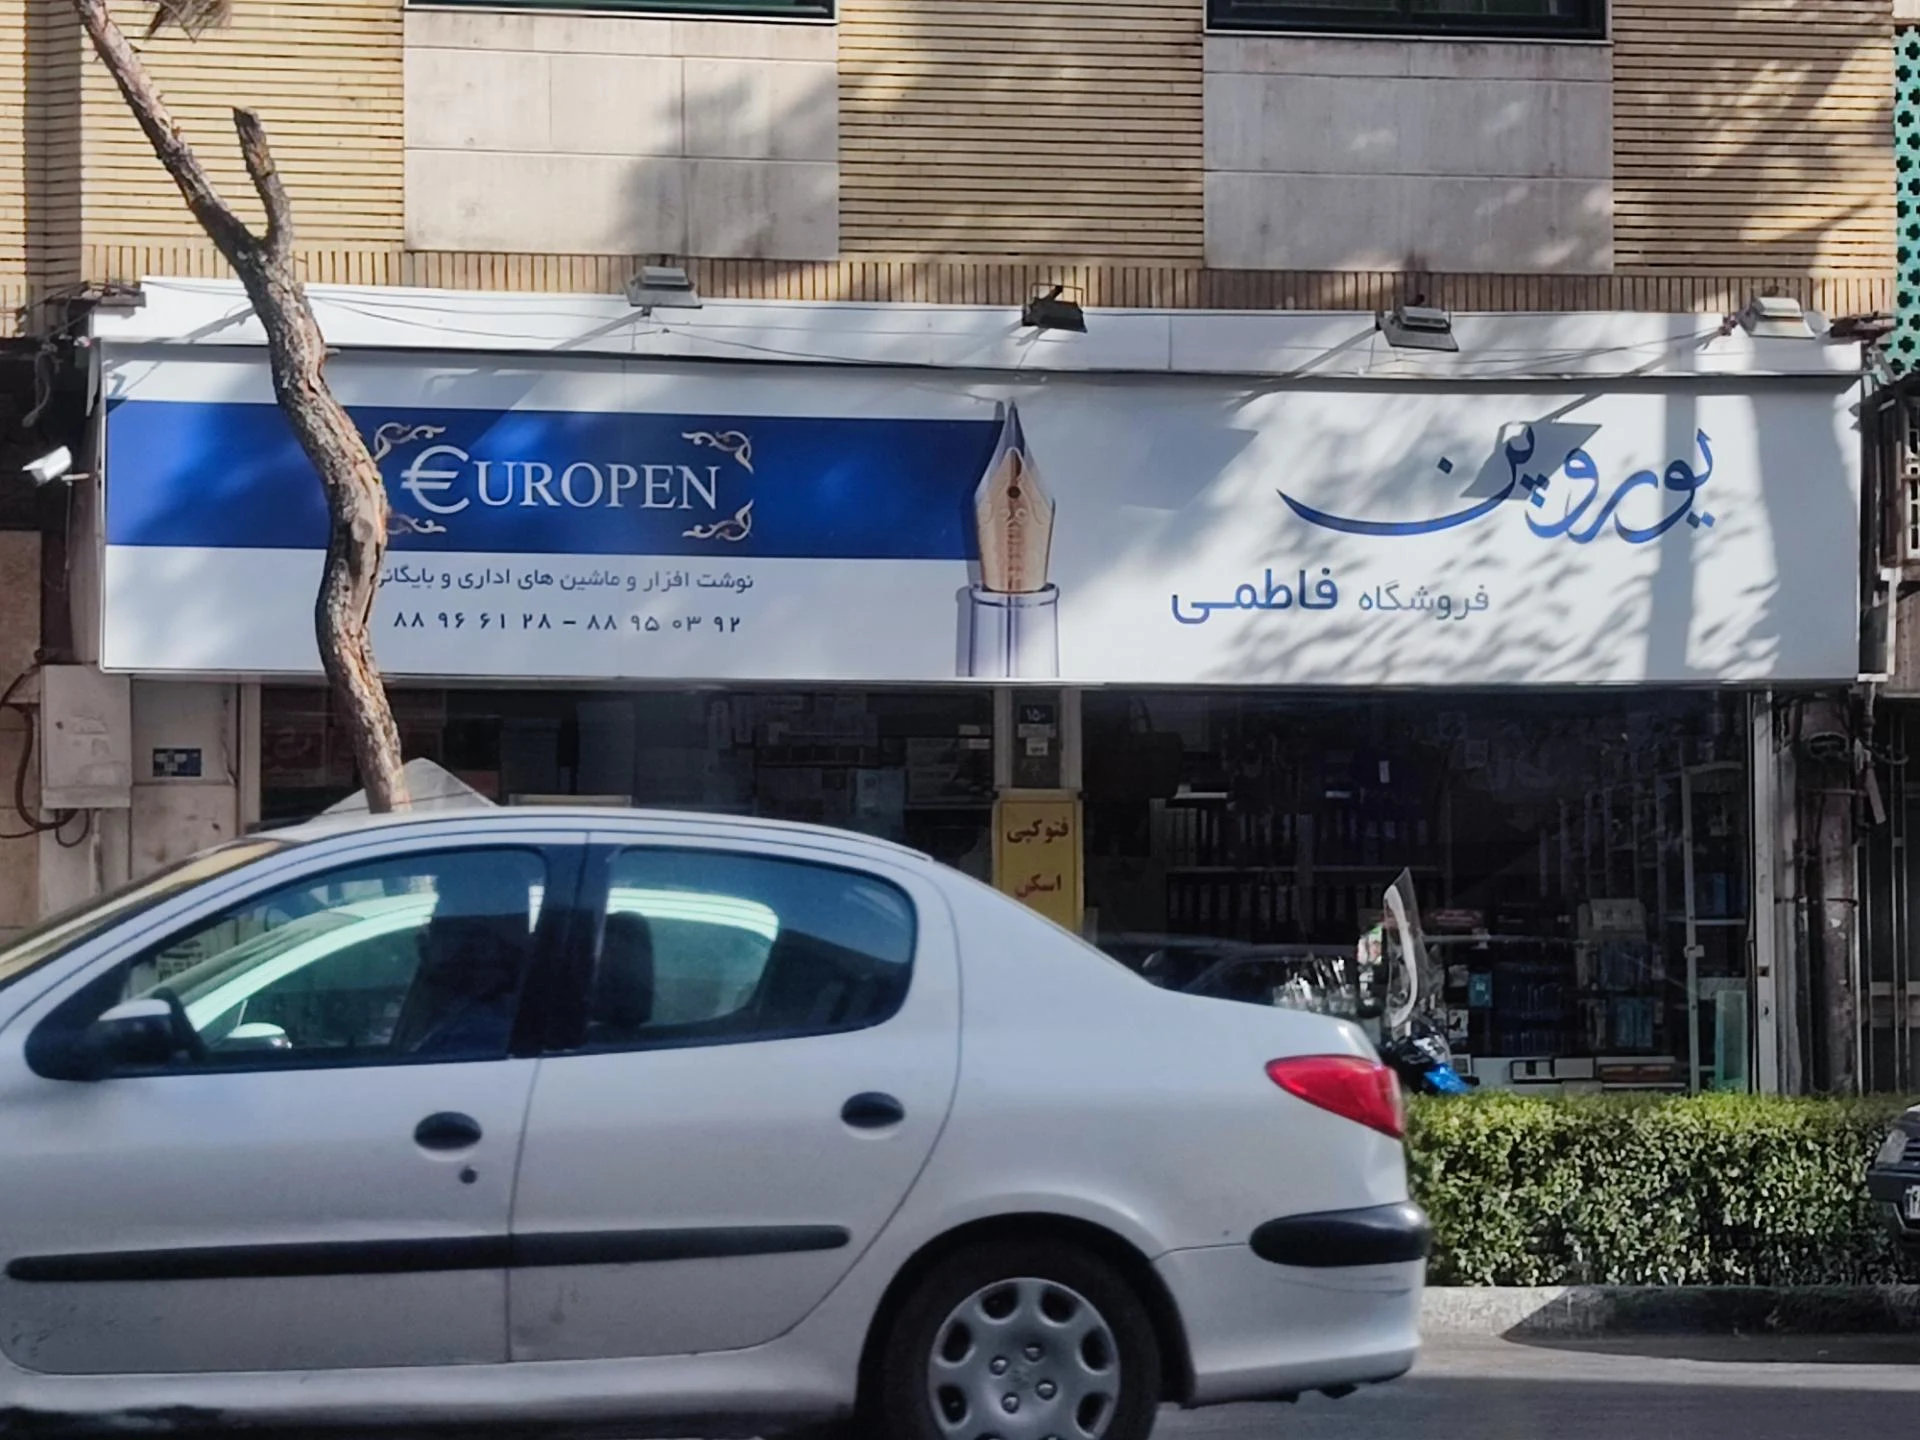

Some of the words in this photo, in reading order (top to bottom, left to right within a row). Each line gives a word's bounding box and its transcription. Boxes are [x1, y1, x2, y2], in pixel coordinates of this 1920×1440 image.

[441, 572, 451, 589] و
[458, 569, 510, 589] اداری
[517, 570, 554, 590] های
[560, 570, 621, 591] ماشین
[627, 575, 637, 592] و
[644, 571, 689, 593] افزار
[697, 572, 754, 593] نوشت
[1173, 568, 1338, 624] فاطمی
[1358, 581, 1489, 620] فروشگاه
